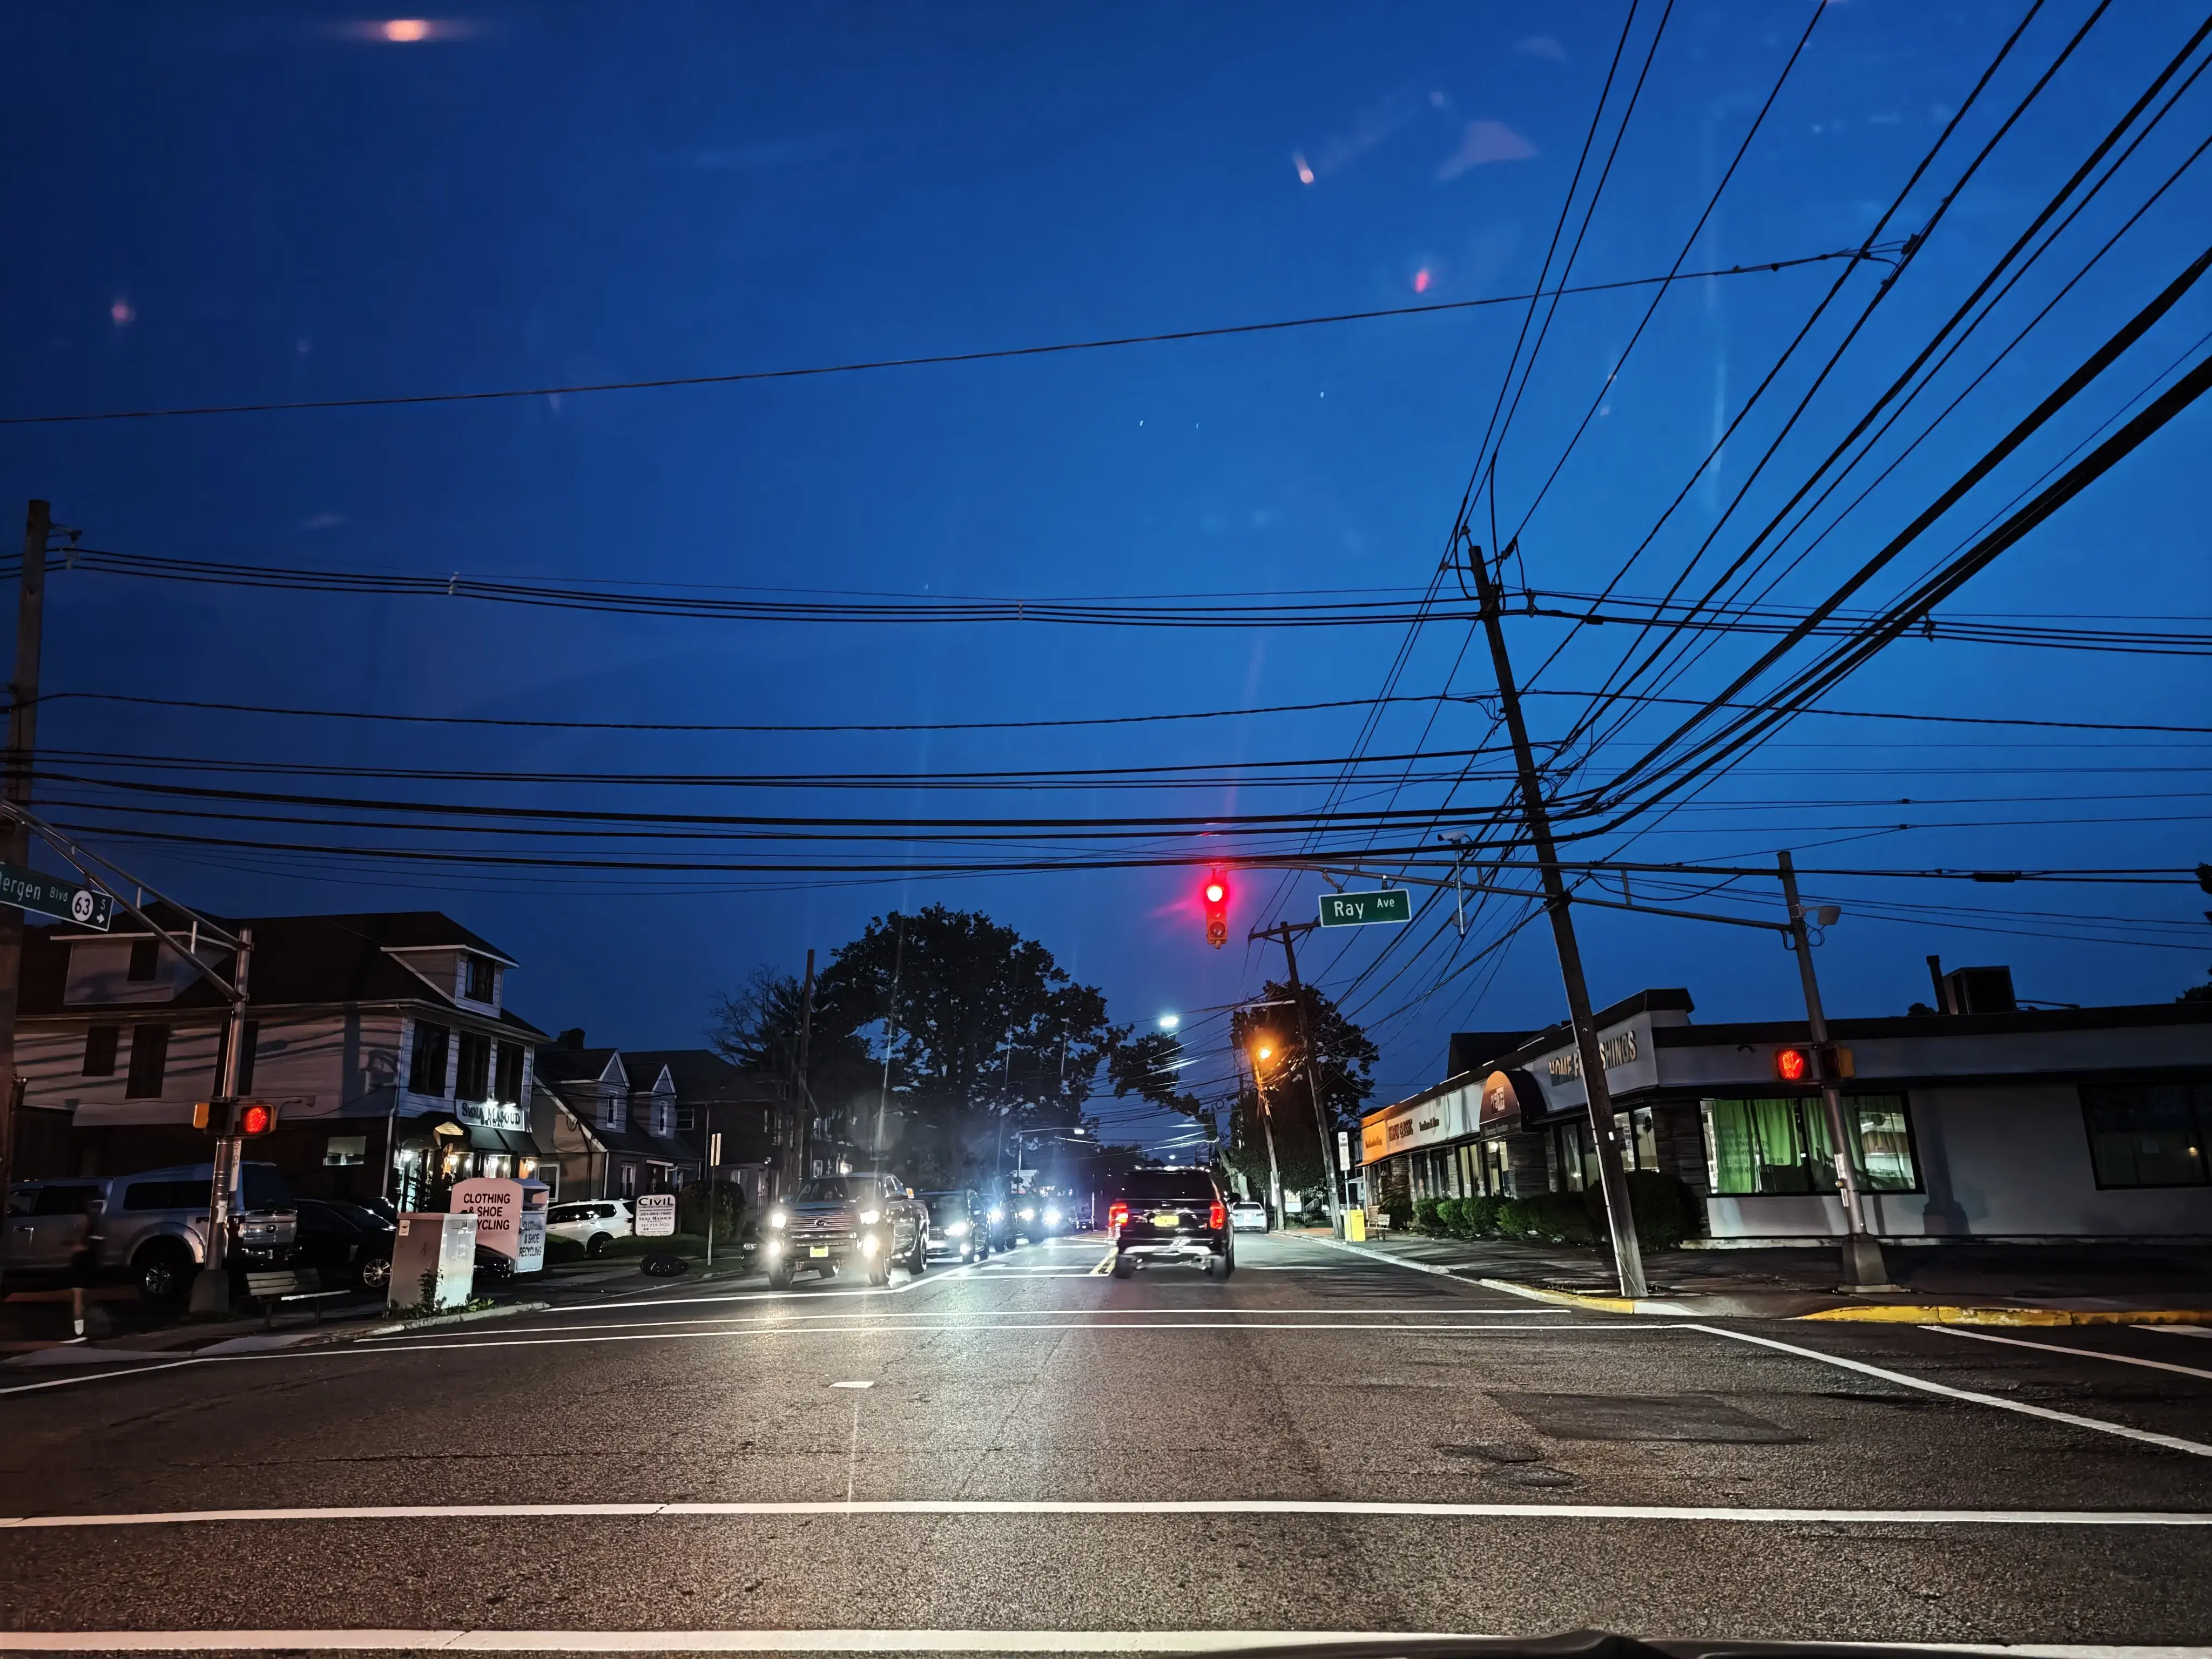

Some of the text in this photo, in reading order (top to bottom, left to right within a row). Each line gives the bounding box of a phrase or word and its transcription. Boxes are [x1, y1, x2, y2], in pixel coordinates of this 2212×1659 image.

[0, 871, 68, 902] ergen Blvd
[75, 896, 91, 916] 63
[100, 899, 106, 910] S
[1334, 898, 1395, 919] Ray Ave
[462, 1102, 521, 1125] SENA MASOUD
[463, 1193, 510, 1204] CLOTHING
[638, 1197, 674, 1205] CIVIL
[468, 1206, 503, 1217] & SHOE
[477, 1219, 509, 1230] YCLING
[524, 1233, 540, 1244] & SHOE
[518, 1246, 542, 1257] RECYCLING
